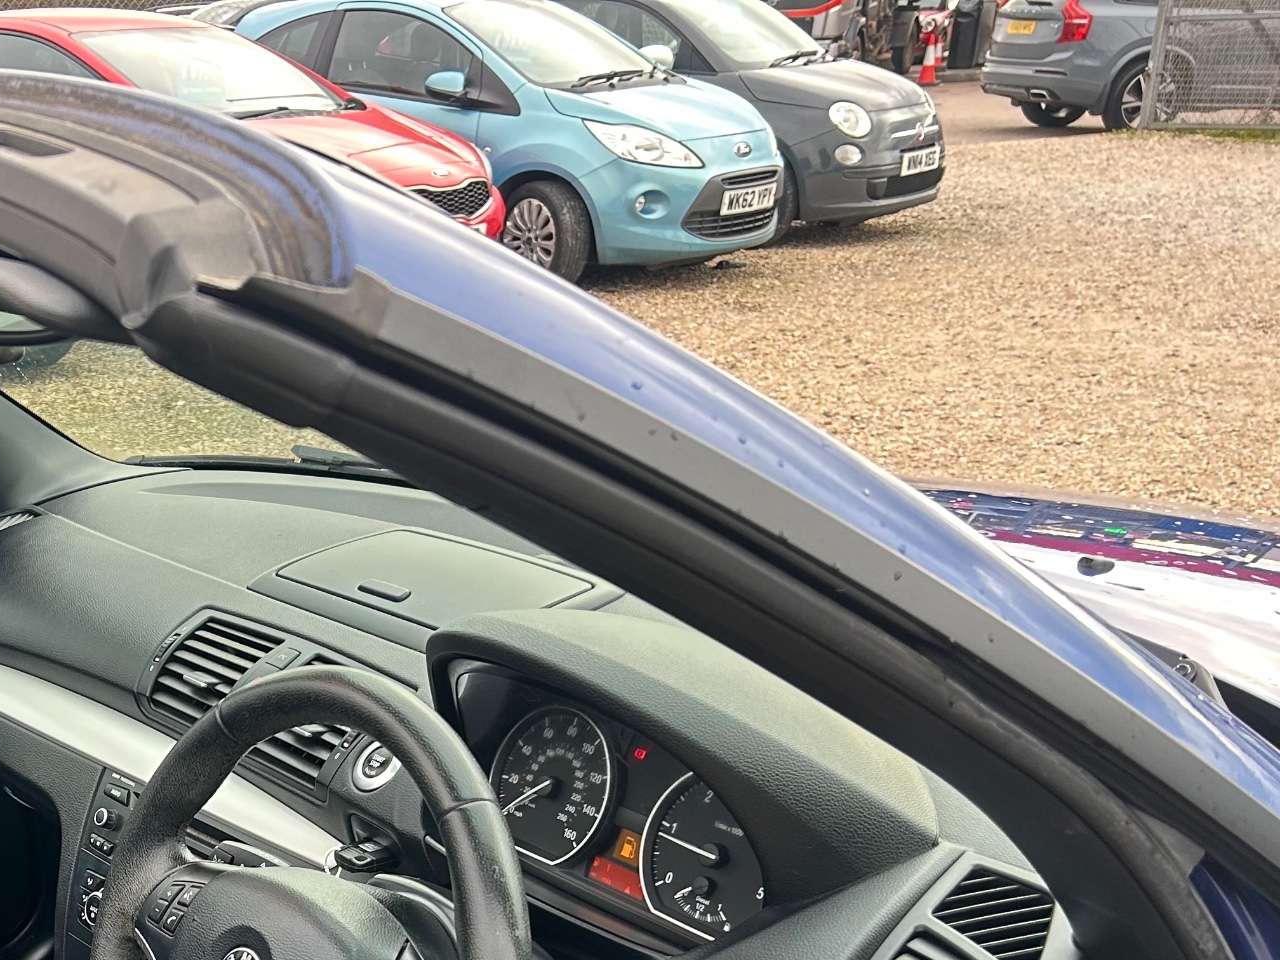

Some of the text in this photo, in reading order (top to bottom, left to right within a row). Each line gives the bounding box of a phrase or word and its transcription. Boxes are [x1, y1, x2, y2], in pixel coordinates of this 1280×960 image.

[726, 190, 756, 211] WK62
[582, 742, 595, 755] 100
[508, 773, 519, 784] 20
[590, 772, 602, 785] 120
[704, 790, 714, 803] 2
[582, 804, 596, 817] 140
[564, 827, 577, 840] 160
[671, 822, 677, 834] 1
[665, 872, 673, 884] 0
[755, 887, 765, 900] 5
